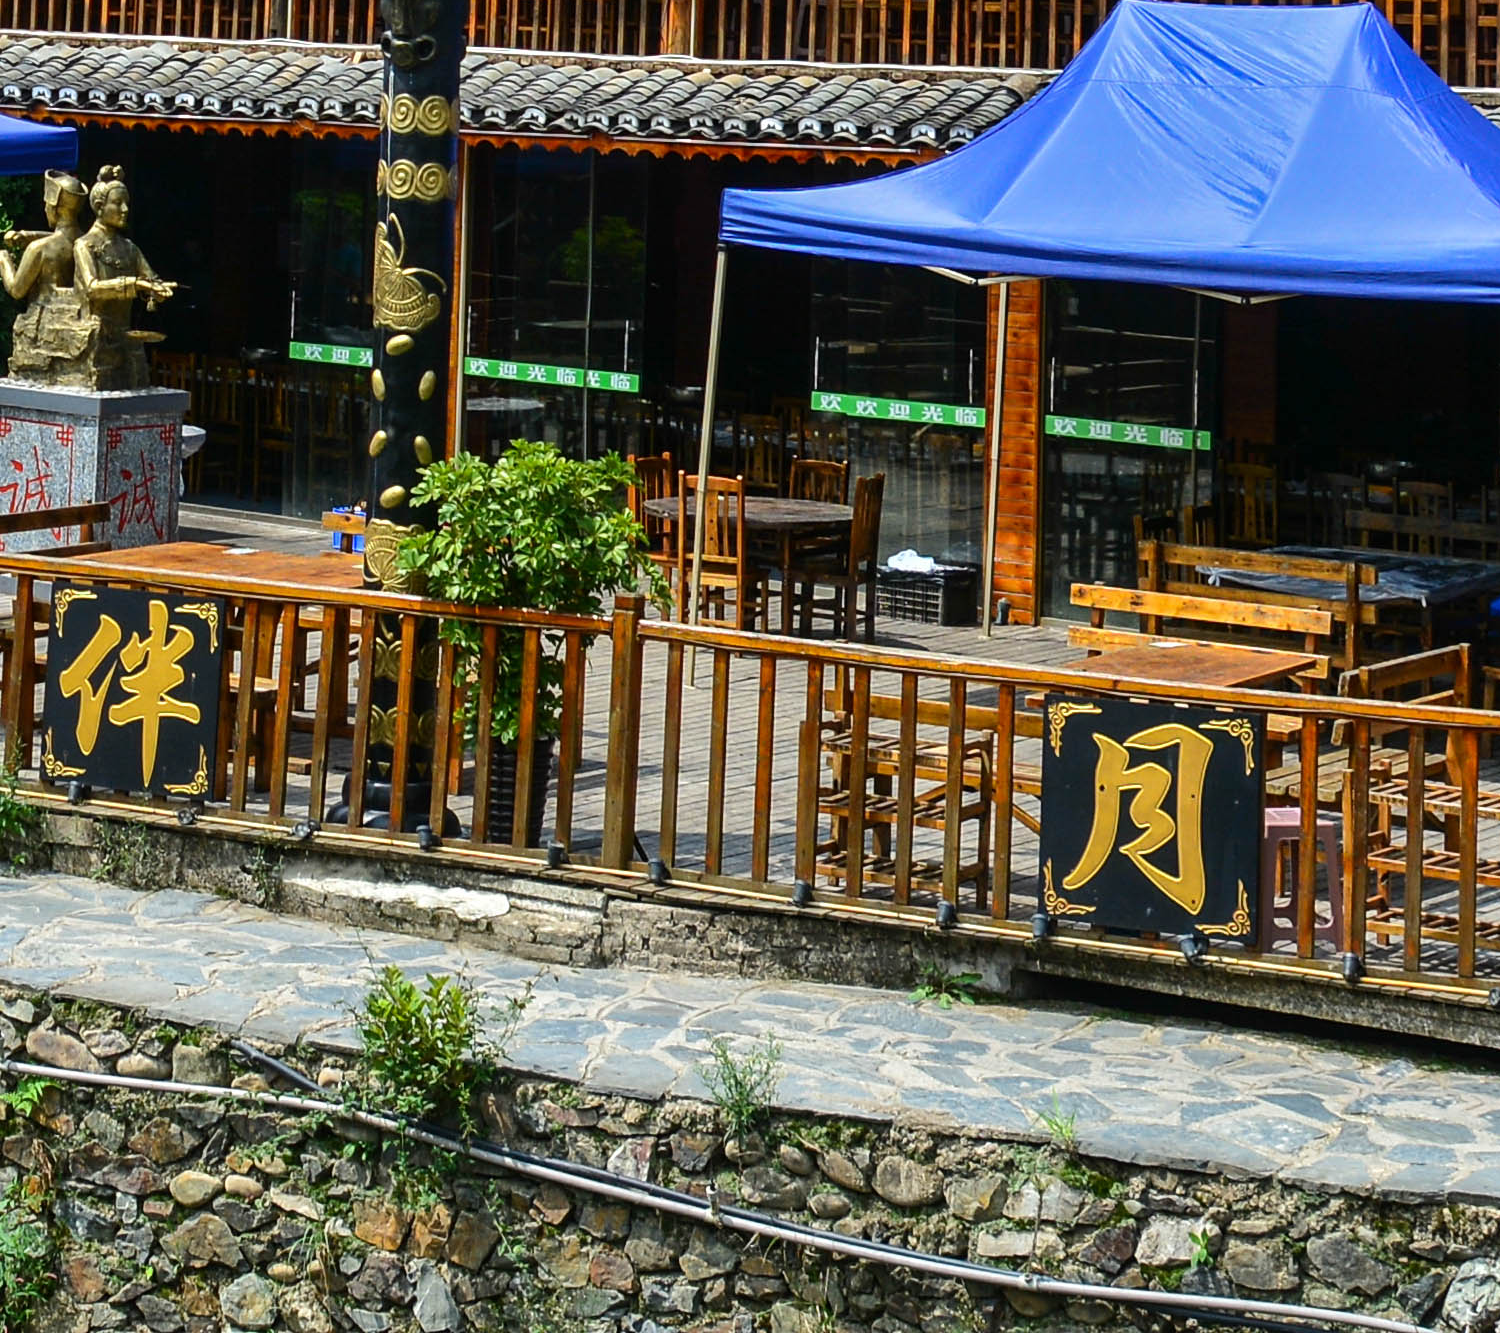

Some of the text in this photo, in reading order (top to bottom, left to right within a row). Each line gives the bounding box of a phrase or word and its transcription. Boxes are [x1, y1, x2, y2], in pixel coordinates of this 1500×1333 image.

[469, 357, 576, 385] 欢迎光临
[856, 400, 977, 426] 欢迎光临
[1053, 417, 1184, 448] 欢迎光临
[109, 449, 163, 539] 诚
[59, 599, 201, 788] 伴
[1064, 723, 1214, 916] 月
